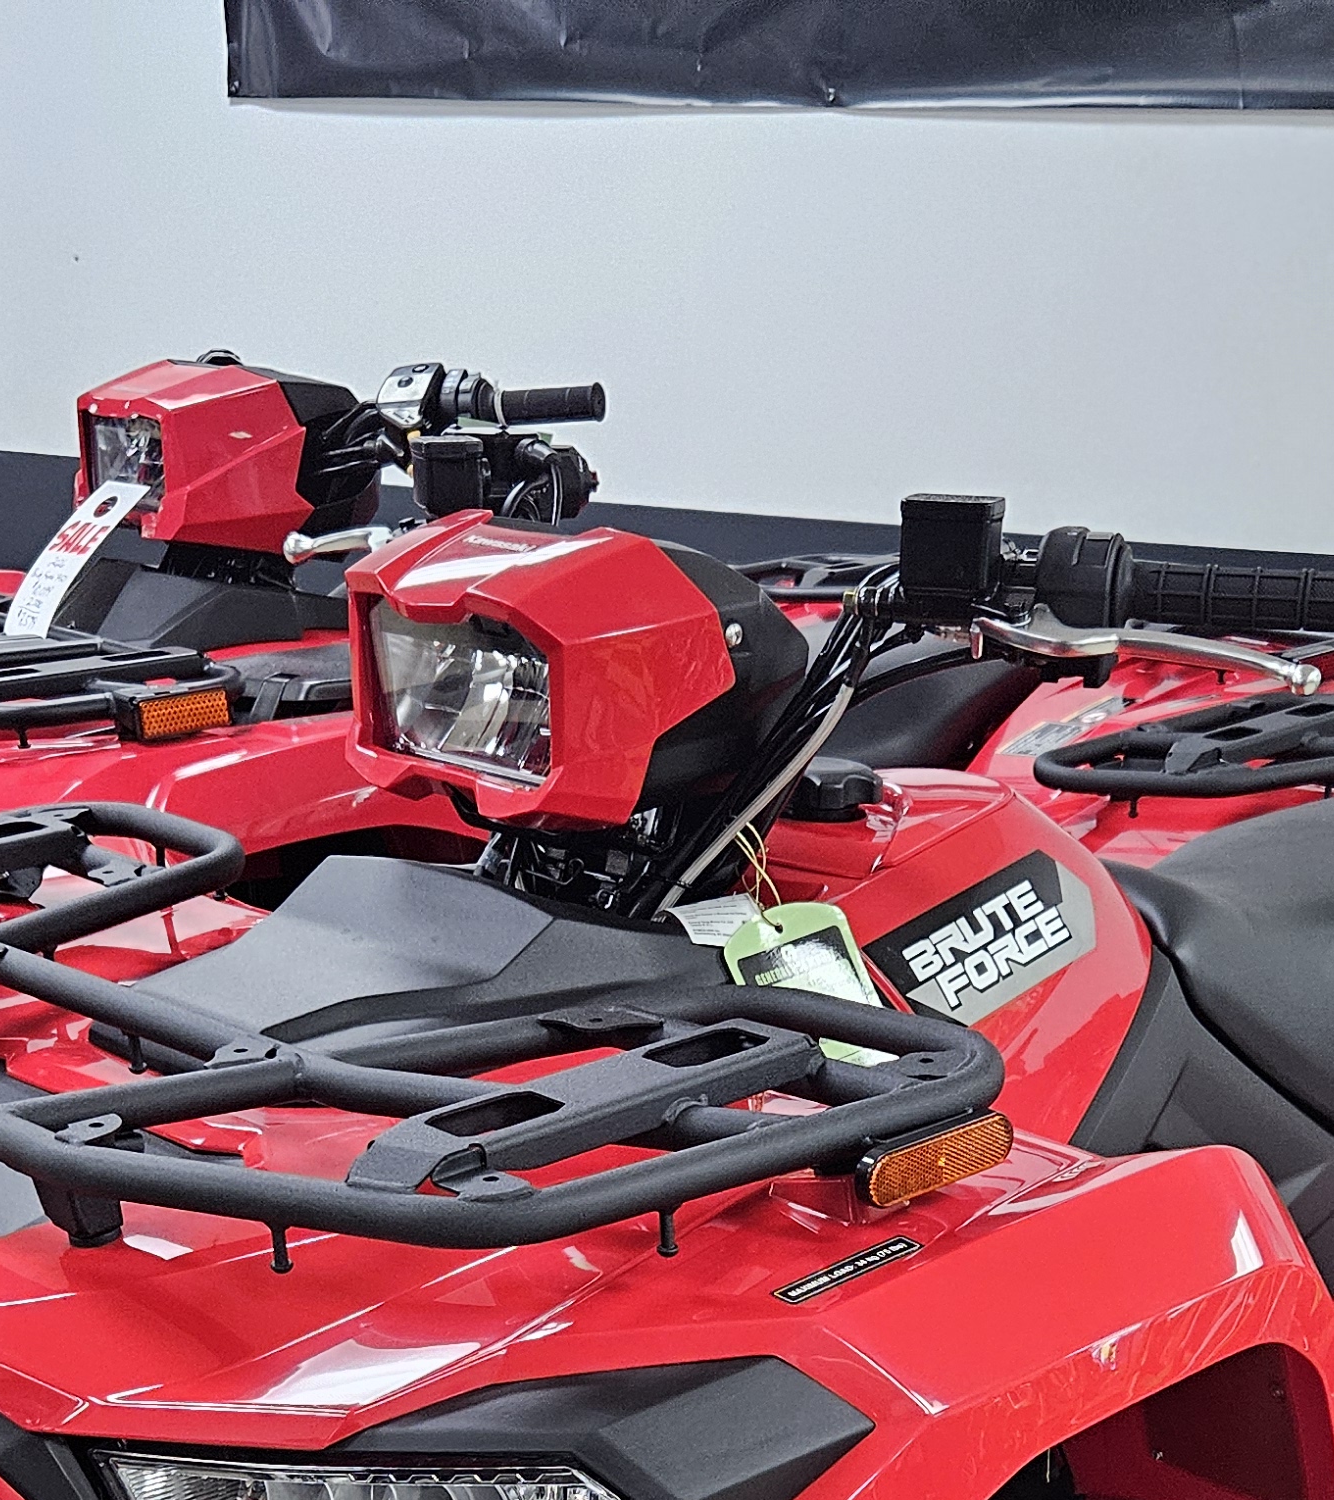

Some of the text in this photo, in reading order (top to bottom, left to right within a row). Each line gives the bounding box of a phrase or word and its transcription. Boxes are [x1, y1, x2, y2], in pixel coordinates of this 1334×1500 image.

[48, 520, 110, 555] SALE
[462, 534, 537, 553] Kawasaki
[901, 879, 1045, 983] BRUTE
[934, 905, 1072, 1011] FORCE
